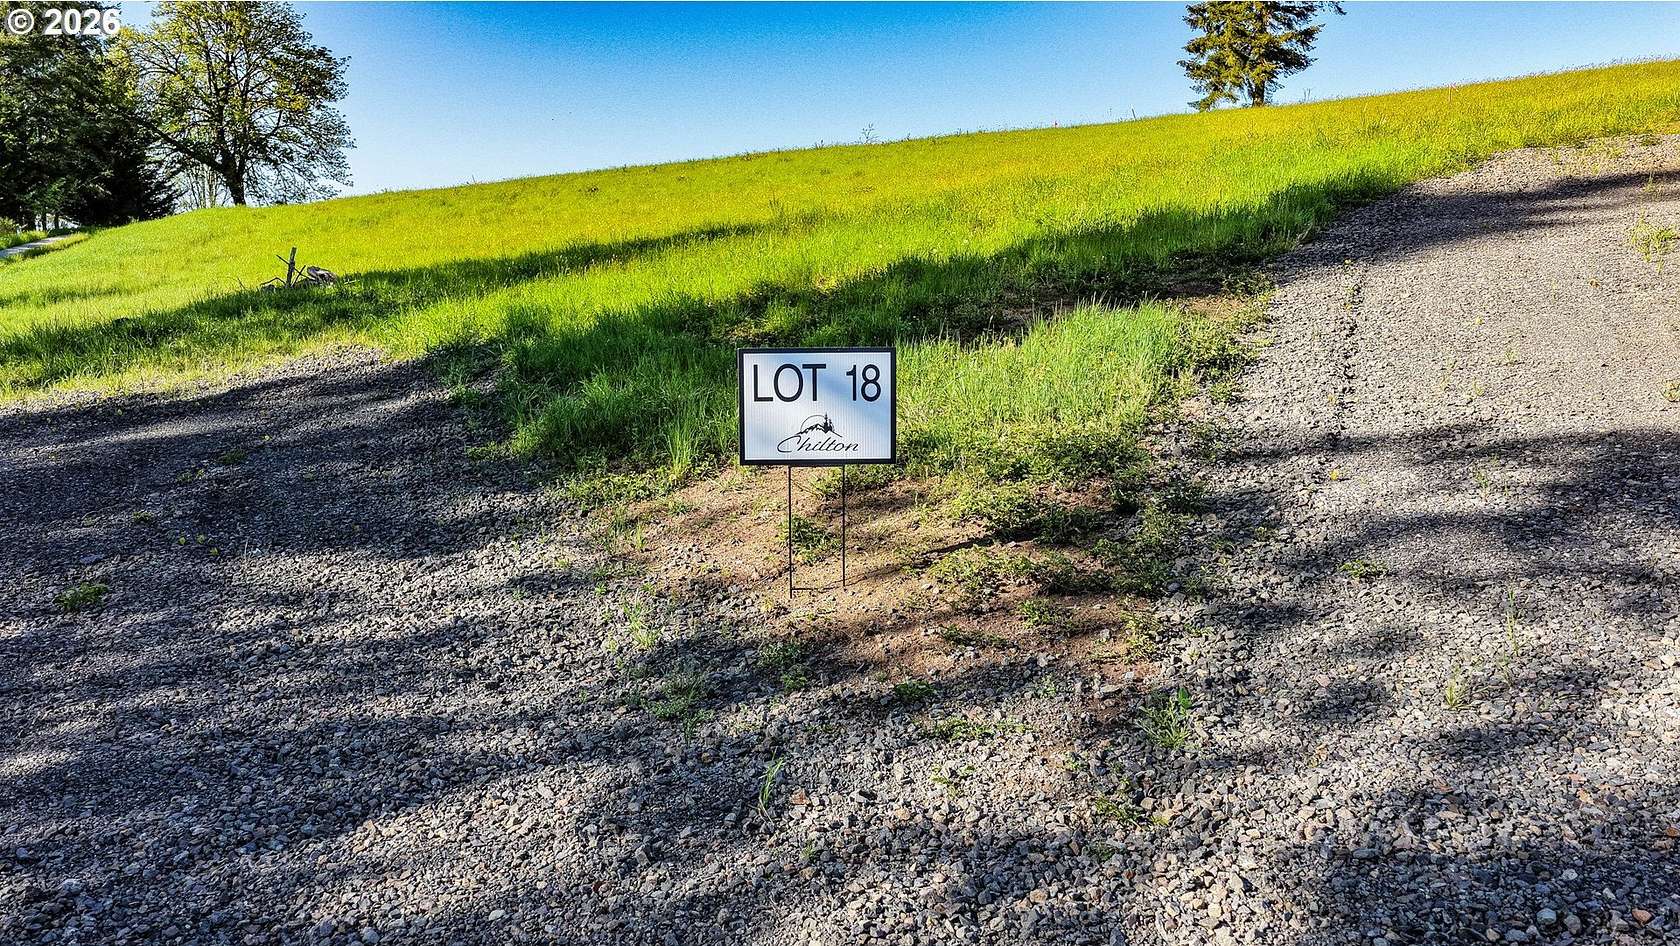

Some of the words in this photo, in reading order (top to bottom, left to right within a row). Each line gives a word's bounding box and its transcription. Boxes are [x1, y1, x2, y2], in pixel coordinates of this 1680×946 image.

[753, 363, 827, 402] LOT
[845, 364, 882, 402] 18
[776, 434, 860, 453] Chilton
